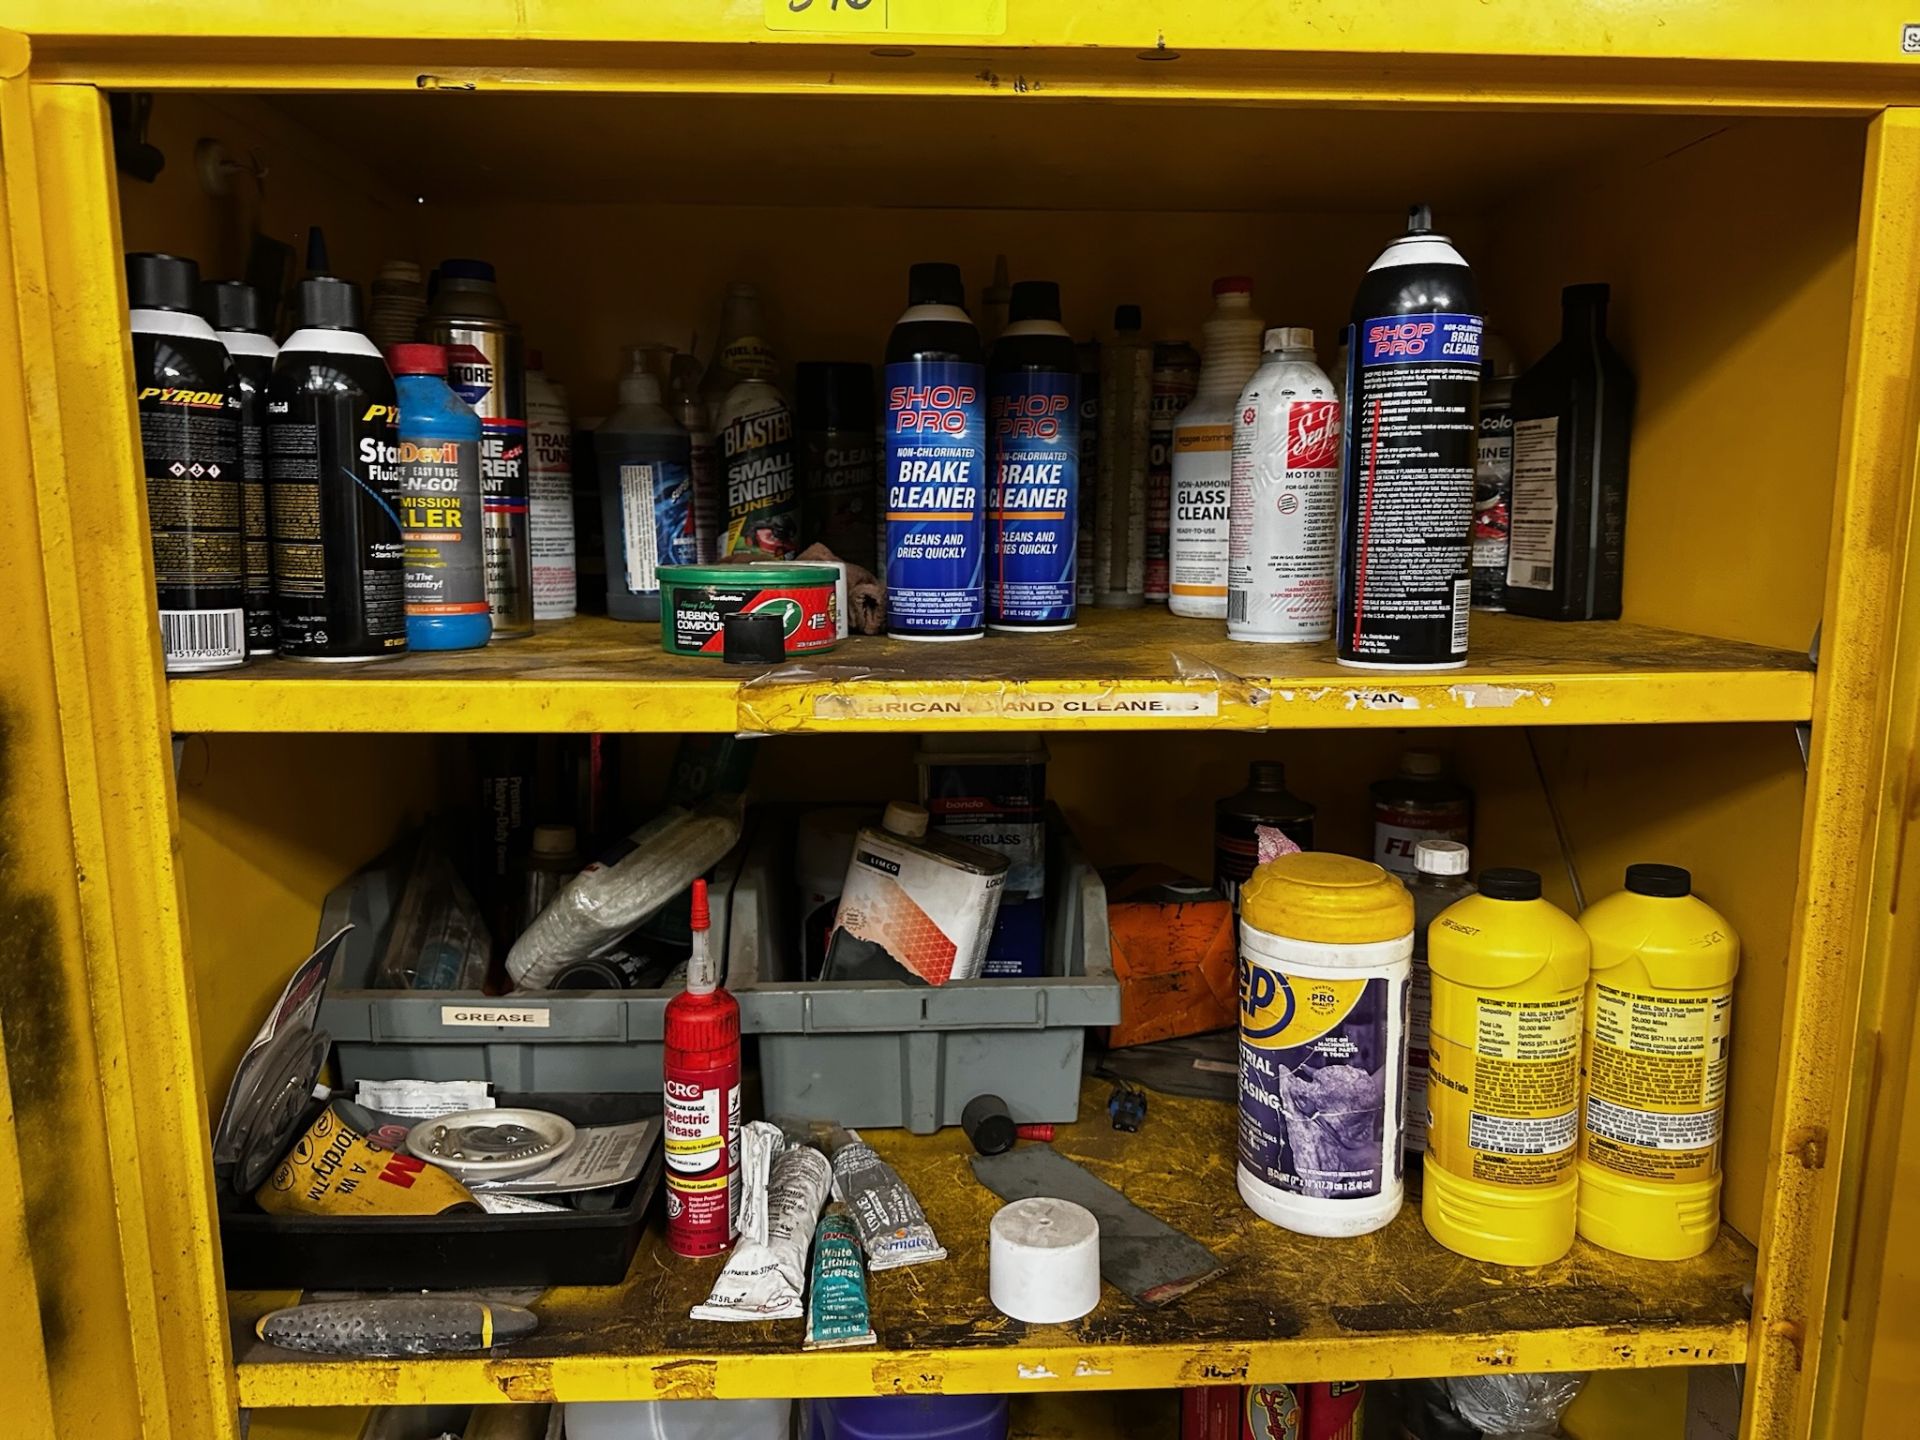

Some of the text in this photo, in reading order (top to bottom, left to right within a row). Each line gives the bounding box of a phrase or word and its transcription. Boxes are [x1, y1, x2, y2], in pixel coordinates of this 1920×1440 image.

[1369, 322, 1435, 344] SHOP
[1451, 331, 1479, 344] BRAKE
[1374, 338, 1426, 357] PRO
[1442, 343, 1480, 357] CLEANER
[138, 387, 225, 406] PYROIL
[889, 385, 977, 411] SHOP
[991, 394, 1070, 417] SHOP
[895, 411, 967, 434] PRO
[995, 417, 1059, 439] PRO
[724, 409, 795, 458] BLASTER
[896, 447, 975, 458] NON-CHLORINATED
[996, 451, 1068, 461] N-CHLORINATED
[727, 452, 795, 487] SMALL
[898, 461, 971, 483] BRAKE
[997, 464, 1063, 485] BRAKE
[1285, 471, 1321, 479] MOTOR
[727, 469, 795, 508] ENGINE
[727, 489, 796, 518] TUNE-UP
[889, 486, 976, 509] CLEANER
[1177, 490, 1225, 505] GLASS
[402, 508, 463, 528] LER
[903, 534, 964, 545] CLEANS AND
[1000, 531, 1056, 542] CLEANS AND
[897, 547, 967, 559] DRIES QUICKLY
[1018, 544, 1058, 555] QUICKLY
[416, 572, 434, 583] The
[677, 610, 720, 621] RUBBING
[866, 699, 1200, 713] BRICAN AND CLEANES
[945, 799, 984, 810] bondo
[962, 833, 1021, 846] ERGLASS
[869, 856, 899, 873] LIMCO
[1311, 993, 1335, 1003] PRO
[1598, 992, 1626, 1006] Compatibility
[1686, 1006, 1705, 1014] Systems
[1636, 994, 1655, 1003] MOTOR
[1656, 996, 1678, 1004] VEHICLE
[454, 1012, 536, 1024] GREASE
[1479, 1006, 1512, 1017] Compatibility
[1597, 1006, 1608, 1015] Fluid
[1631, 1015, 1651, 1025] 50,000
[1632, 1008, 1657, 1017] Requiring
[1596, 1013, 1658, 1033] Fluid Type Synthetic
[1517, 1033, 1543, 1041] Synthetic
[1596, 1021, 1624, 1034] Specification
[1630, 1031, 1650, 1041] FMVSS
[1479, 1036, 1510, 1046] Specification
[1595, 1034, 1693, 1057] Protection within braking system
[1596, 1028, 1616, 1040] Corrosion
[1630, 1039, 1652, 1049] Prevents
[1478, 1049, 1503, 1058] Protection
[666, 1080, 701, 1098] CRC
[1454, 1081, 1469, 1094] Fade
[666, 1121, 703, 1138] Grease
[676, 1181, 697, 1190] Electrical
[688, 1194, 723, 1203] Unique Precision
[821, 1247, 853, 1258] White
[821, 1257, 862, 1270] Lithium
[821, 1268, 861, 1279] Grease
